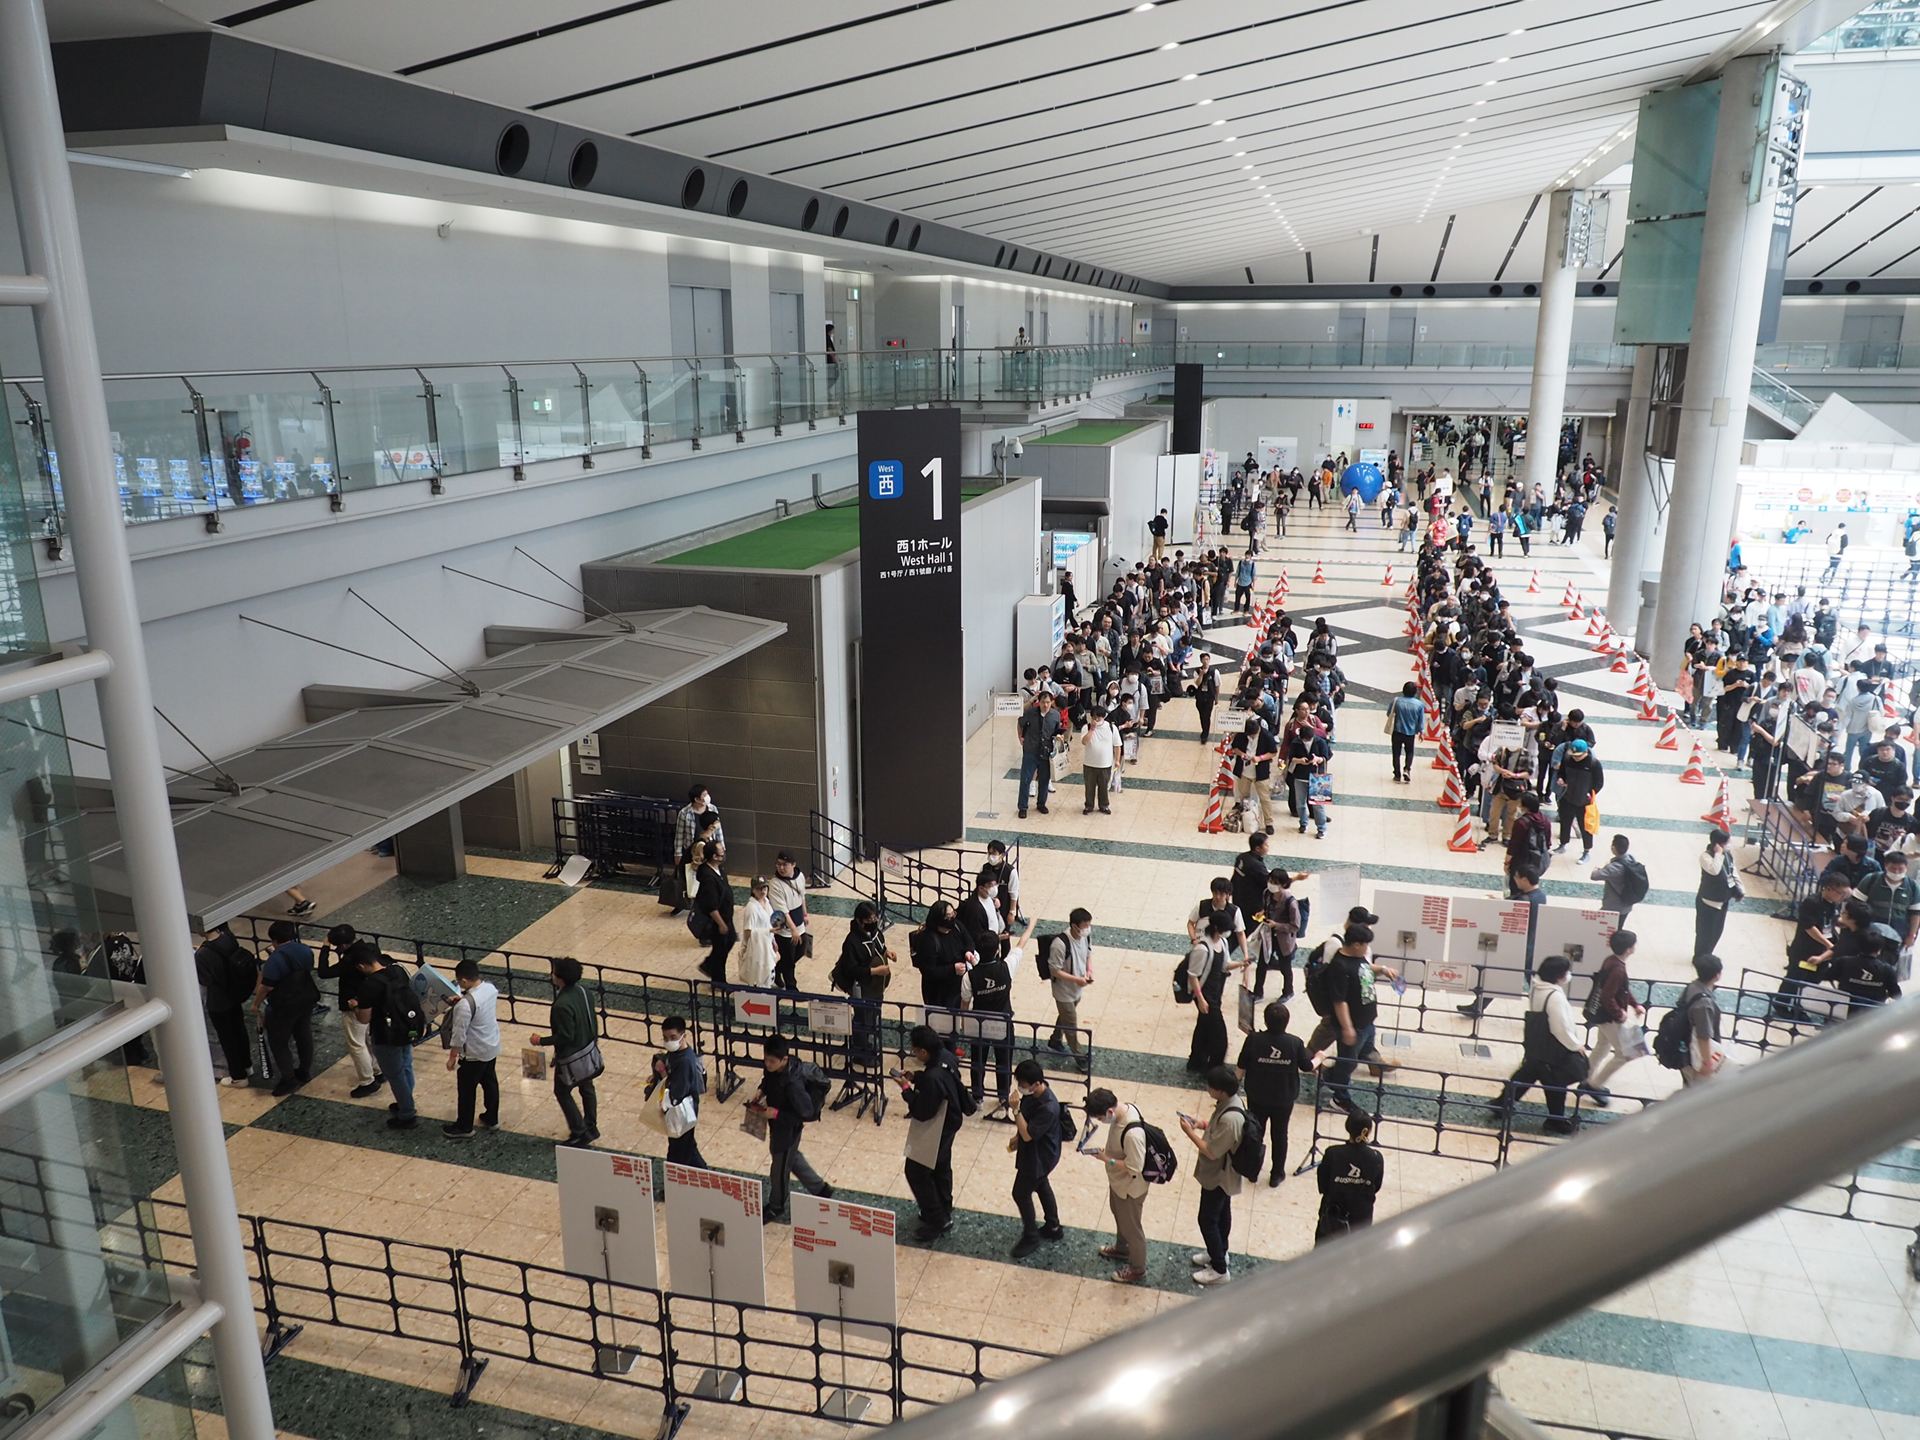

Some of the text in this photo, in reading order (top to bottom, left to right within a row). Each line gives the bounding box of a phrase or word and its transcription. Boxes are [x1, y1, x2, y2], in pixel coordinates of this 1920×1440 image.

[877, 465, 894, 473] West
[878, 474, 894, 496] 西
[920, 457, 943, 521] 1
[896, 536, 953, 553] 西1ホール
[900, 551, 953, 567] West Hall 1
